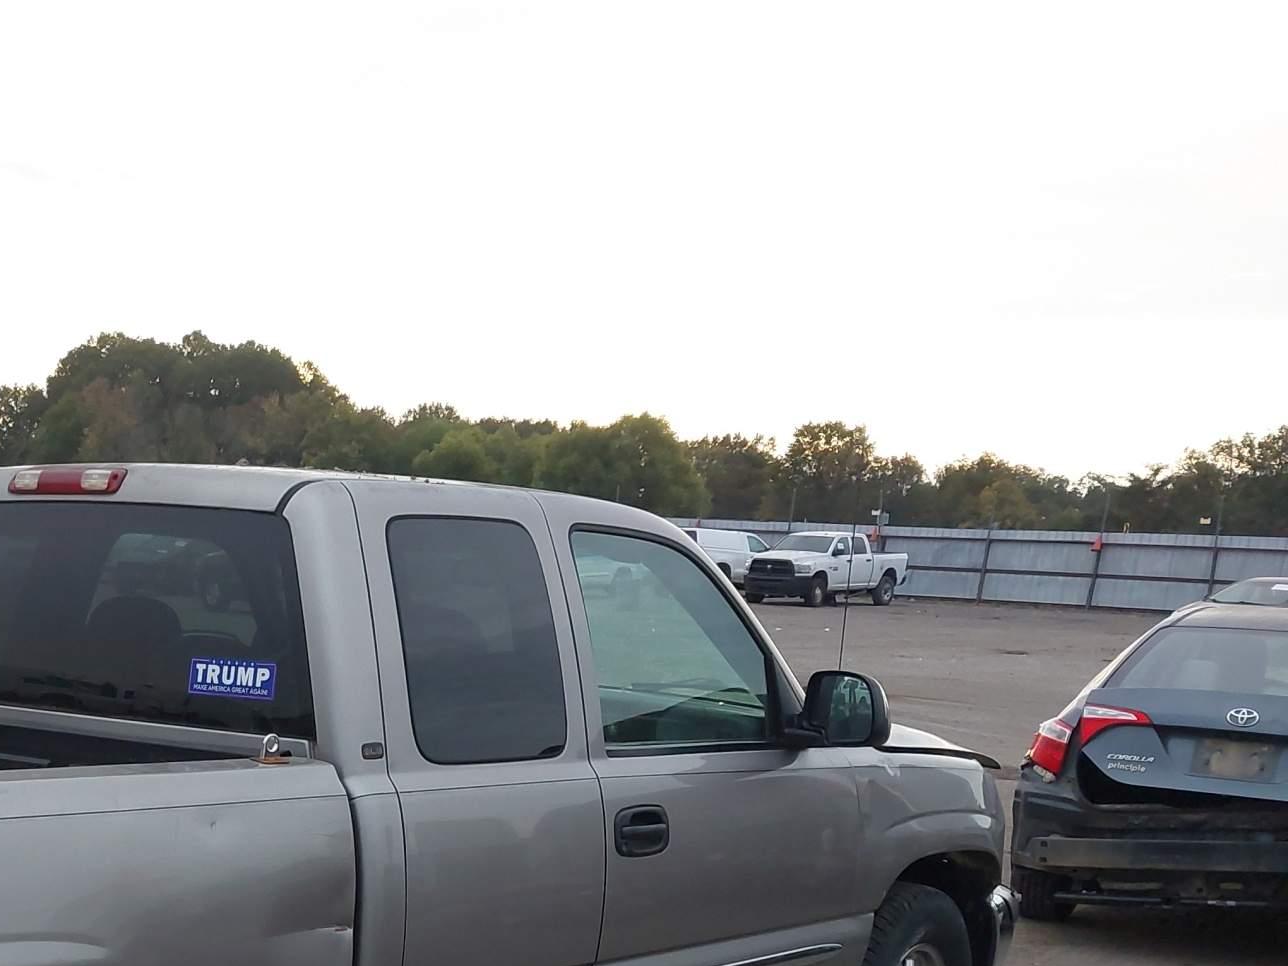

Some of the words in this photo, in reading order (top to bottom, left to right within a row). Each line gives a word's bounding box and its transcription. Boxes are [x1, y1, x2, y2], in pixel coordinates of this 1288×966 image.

[196, 663, 270, 687] TRUMP
[1107, 753, 1154, 762] COROLLA
[1108, 762, 1146, 772] principle
